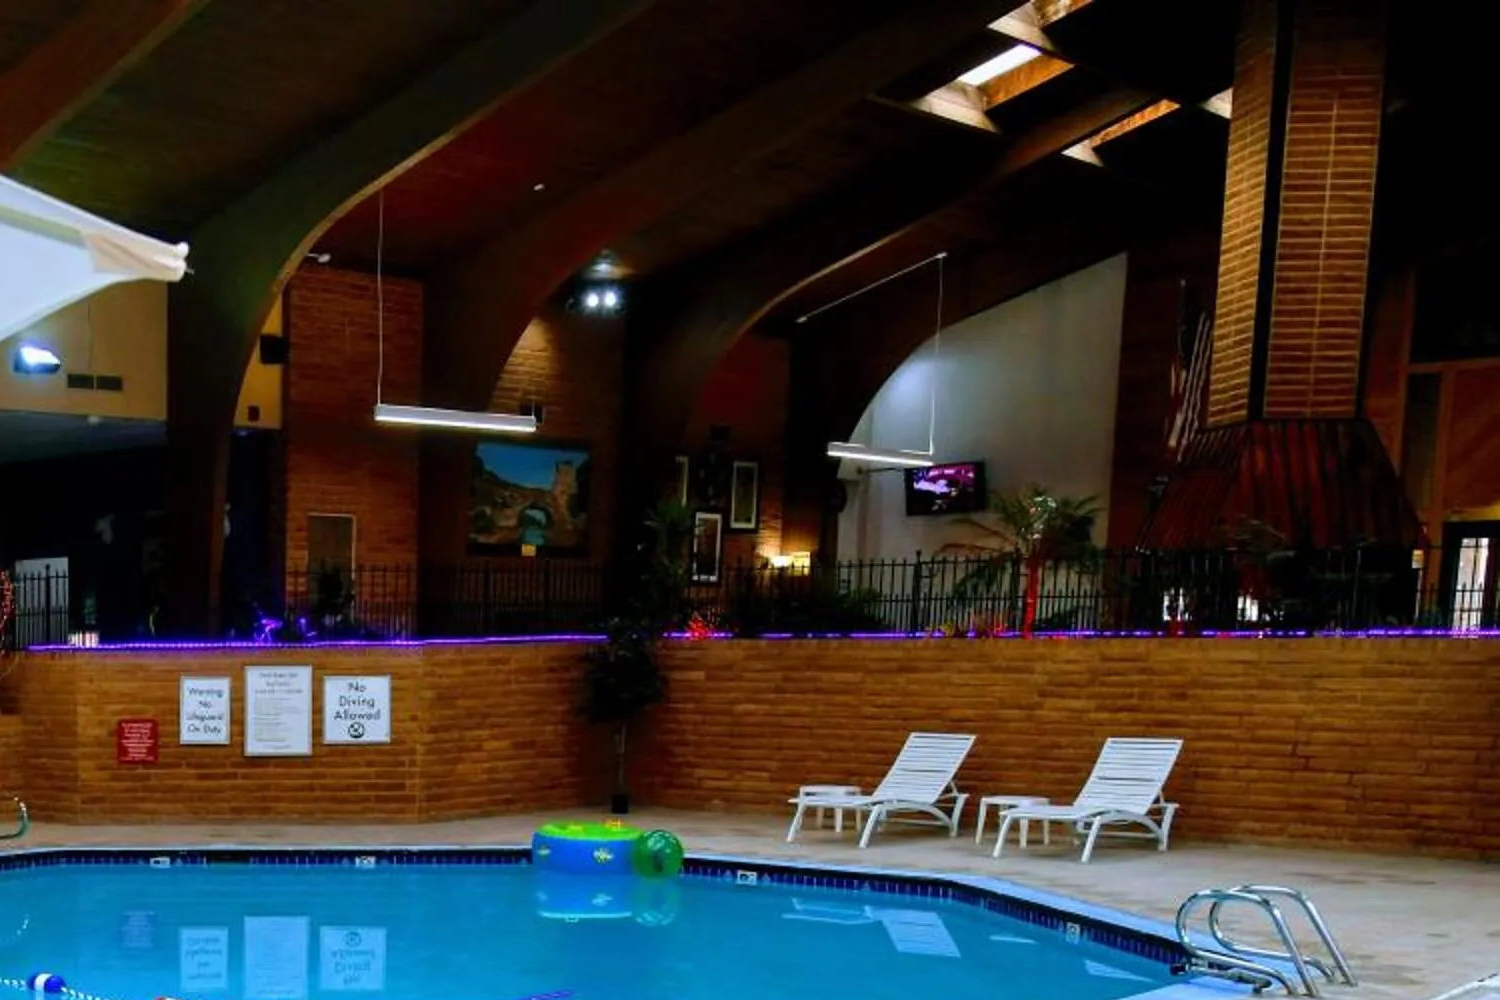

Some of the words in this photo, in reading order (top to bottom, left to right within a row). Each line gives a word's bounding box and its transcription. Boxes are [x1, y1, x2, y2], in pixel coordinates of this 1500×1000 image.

[348, 682, 367, 693] No
[339, 695, 375, 709] Diving
[333, 708, 381, 720] Allowed
